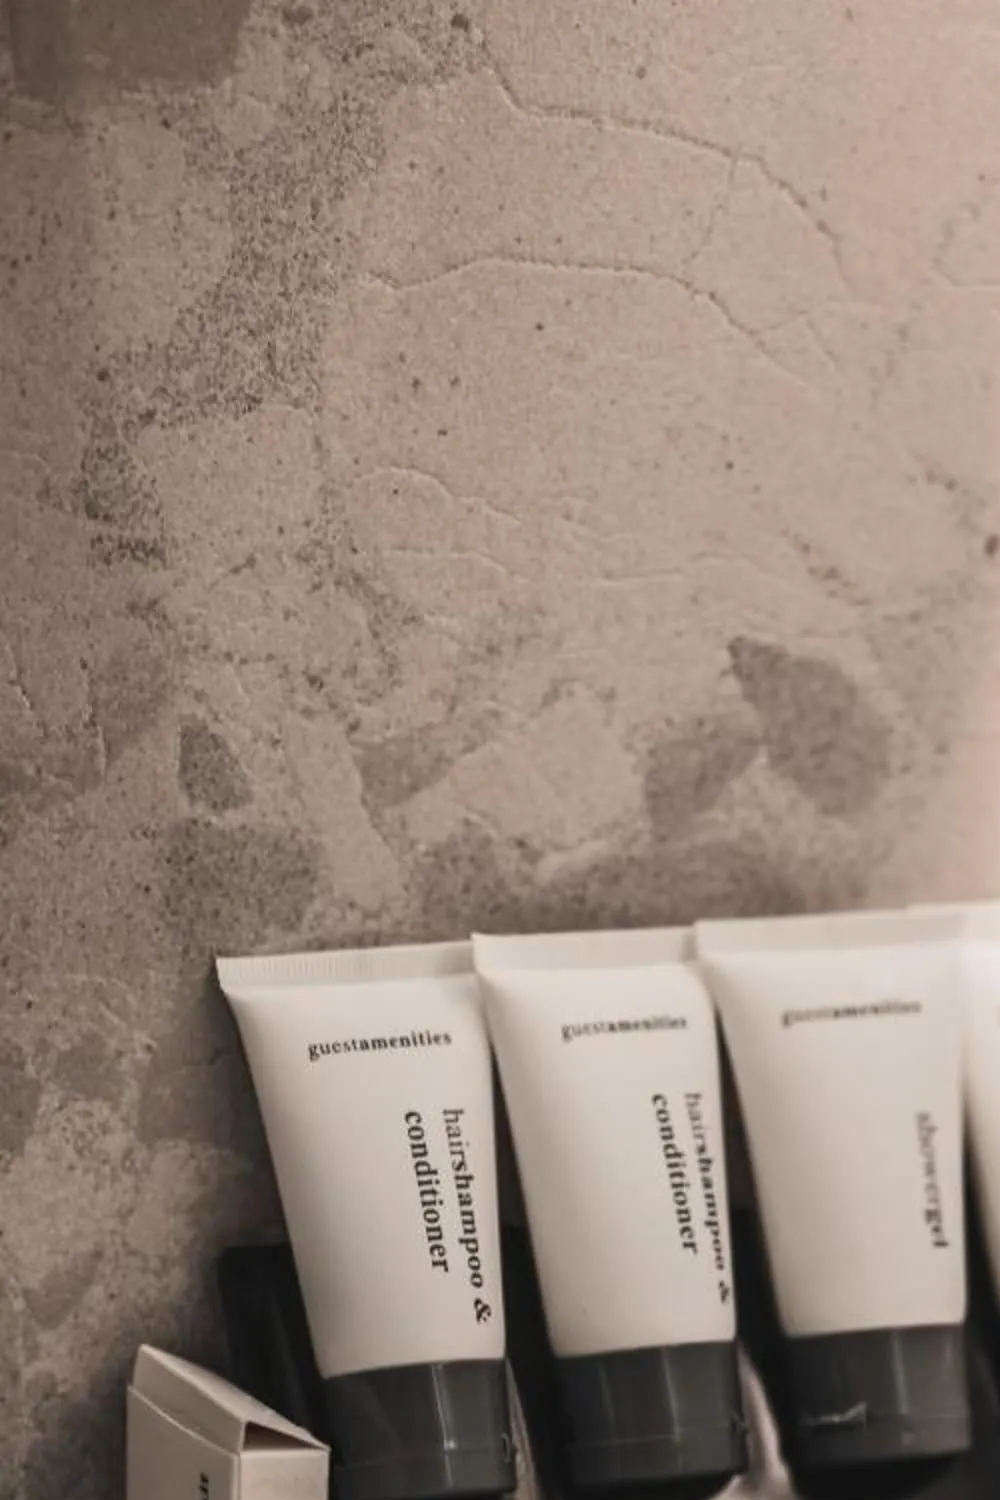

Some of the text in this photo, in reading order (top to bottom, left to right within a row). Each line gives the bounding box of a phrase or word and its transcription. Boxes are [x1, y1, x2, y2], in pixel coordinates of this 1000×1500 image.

[307, 1028, 453, 1063] guestamenities
[404, 1109, 450, 1274] conditioner
[442, 1107, 493, 1325] hairshampoo &
[651, 1092, 699, 1257] conditioner
